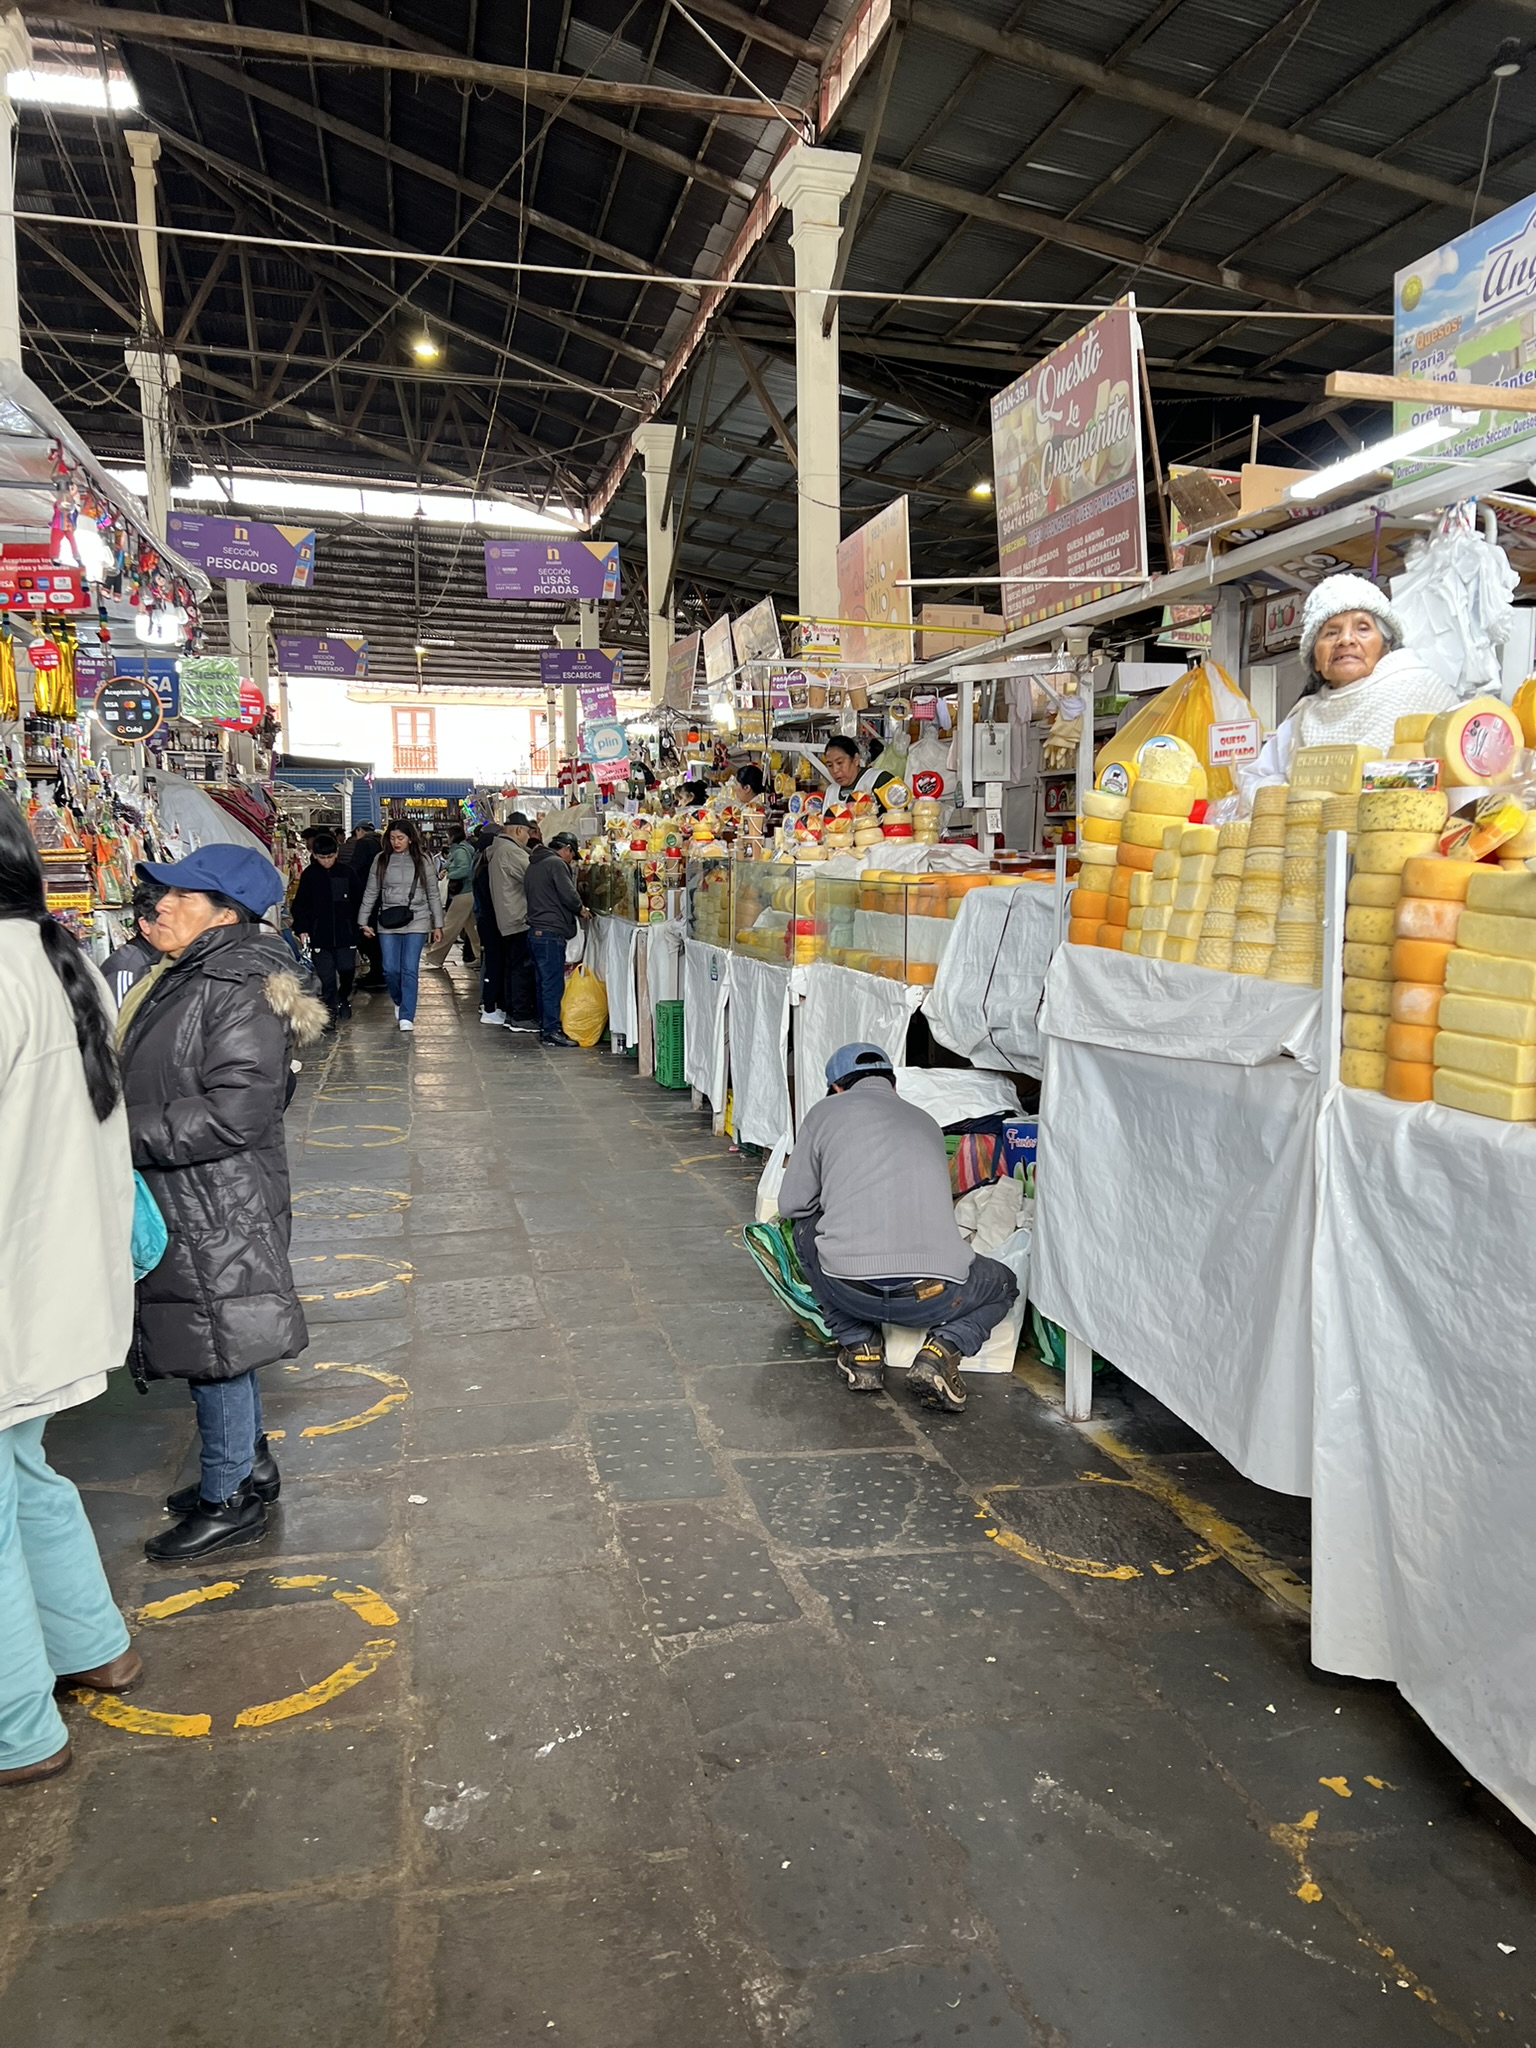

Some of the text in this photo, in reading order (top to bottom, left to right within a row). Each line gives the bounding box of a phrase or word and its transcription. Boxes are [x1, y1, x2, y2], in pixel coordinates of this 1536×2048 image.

[1414, 315, 1462, 351] Quesos:
[1411, 350, 1444, 374] Paria
[1036, 330, 1103, 423] Quesito
[993, 381, 1029, 420] STAN-391
[1066, 400, 1080, 428] La
[1040, 394, 1132, 497] Cusqueñita
[222, 546, 260, 557] SECCIÓN
[206, 556, 278, 575] PESCADOS
[538, 567, 571, 575] SECCIÓN
[540, 575, 571, 584] LISAS
[533, 585, 579, 594] PICADAS
[562, 671, 602, 679] ESCABECHE
[597, 737, 619, 751] plin
